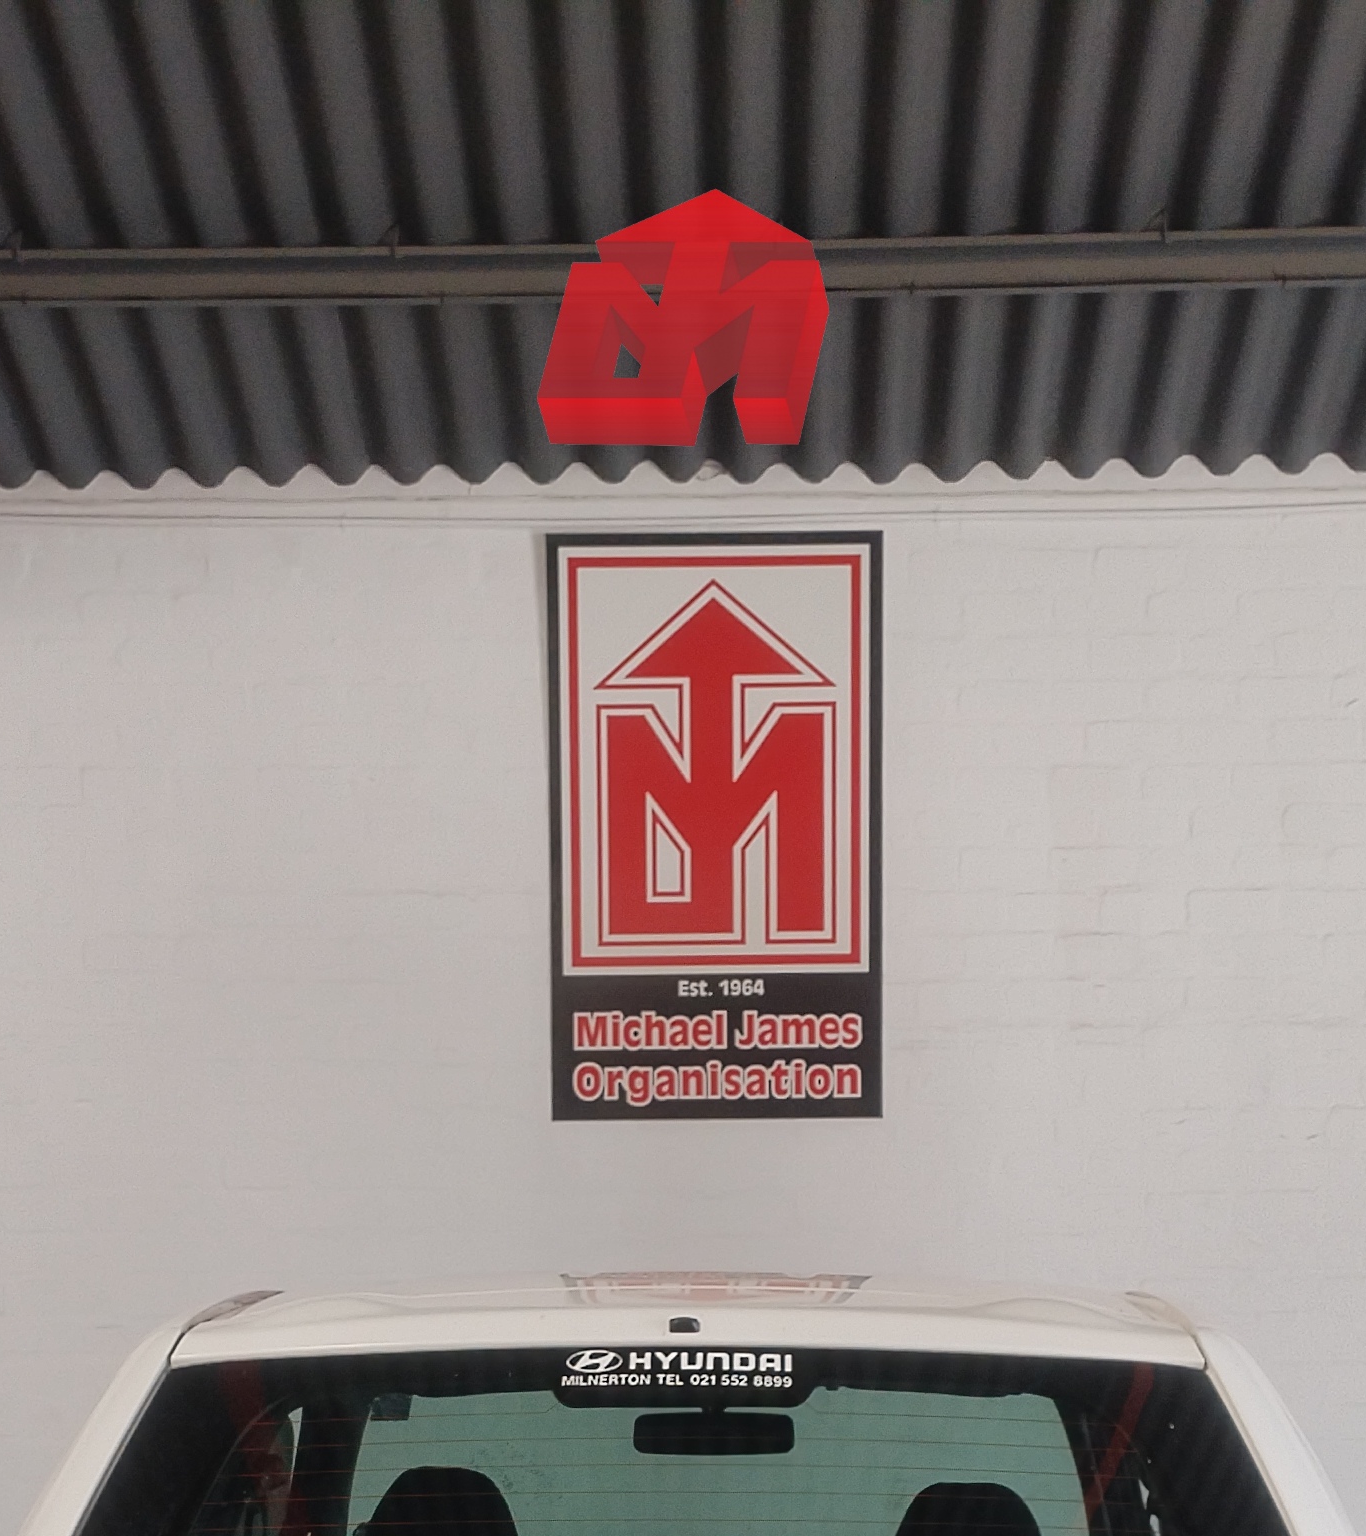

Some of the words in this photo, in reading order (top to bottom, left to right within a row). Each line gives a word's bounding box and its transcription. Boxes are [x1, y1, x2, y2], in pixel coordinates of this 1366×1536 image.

[678, 980, 713, 997] Est.
[719, 979, 764, 996] 1964
[574, 1010, 728, 1051] Michael
[735, 1010, 863, 1049] James
[573, 1059, 862, 1107] Organisation
[629, 1352, 792, 1372] HYUNDAI
[562, 1374, 651, 1386] MILNERTON
[656, 1374, 684, 1385] TEL
[690, 1374, 716, 1385] 021
[721, 1374, 748, 1386] 552
[753, 1375, 792, 1387] 8899
